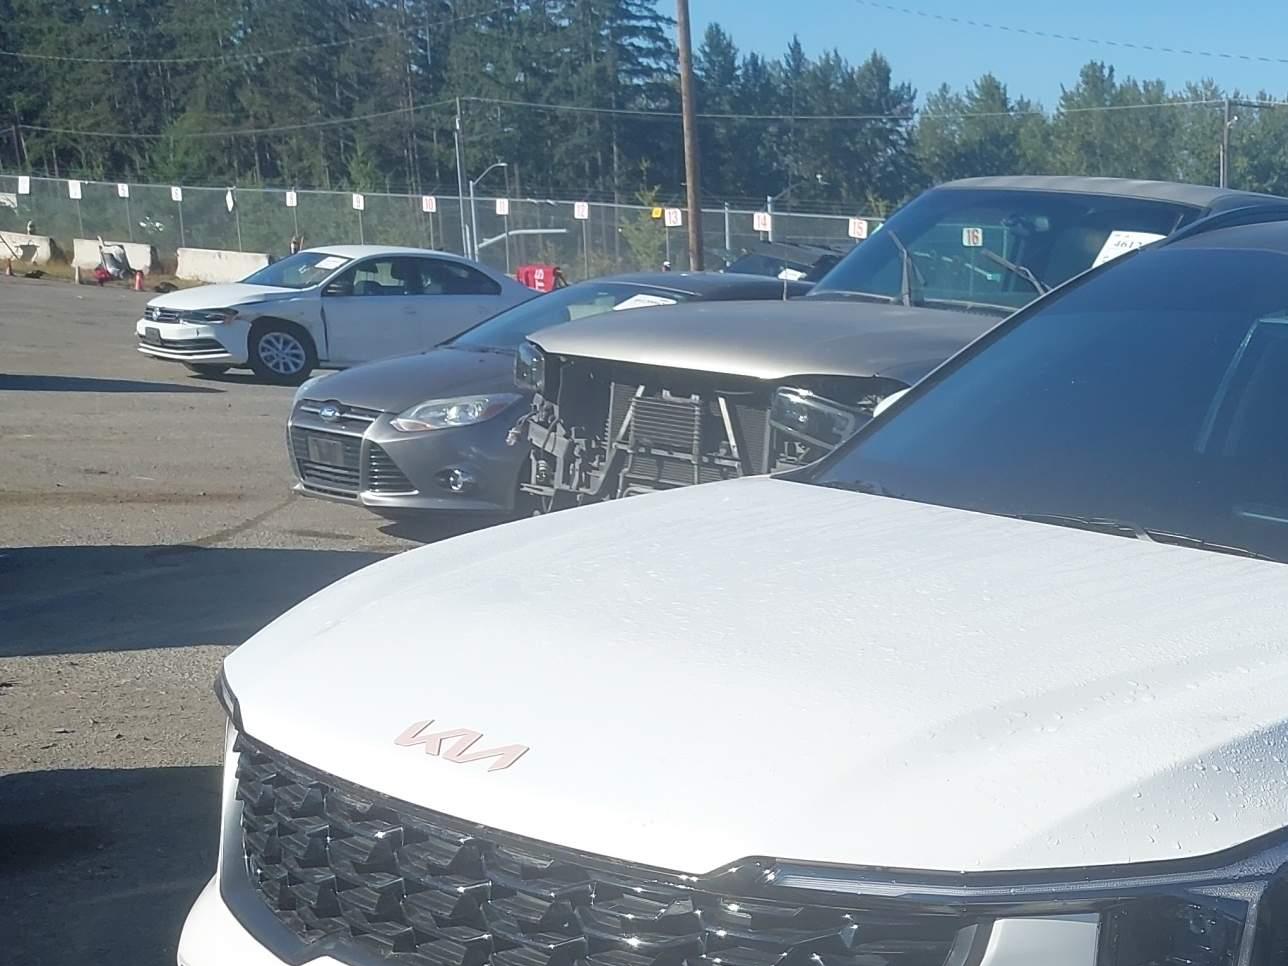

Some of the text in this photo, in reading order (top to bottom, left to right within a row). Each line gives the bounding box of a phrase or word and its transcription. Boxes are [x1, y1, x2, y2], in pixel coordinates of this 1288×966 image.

[668, 210, 679, 225] 13
[757, 214, 768, 228] 14
[853, 220, 864, 237] 15
[967, 229, 980, 245] 16
[393, 719, 530, 772] KIA
